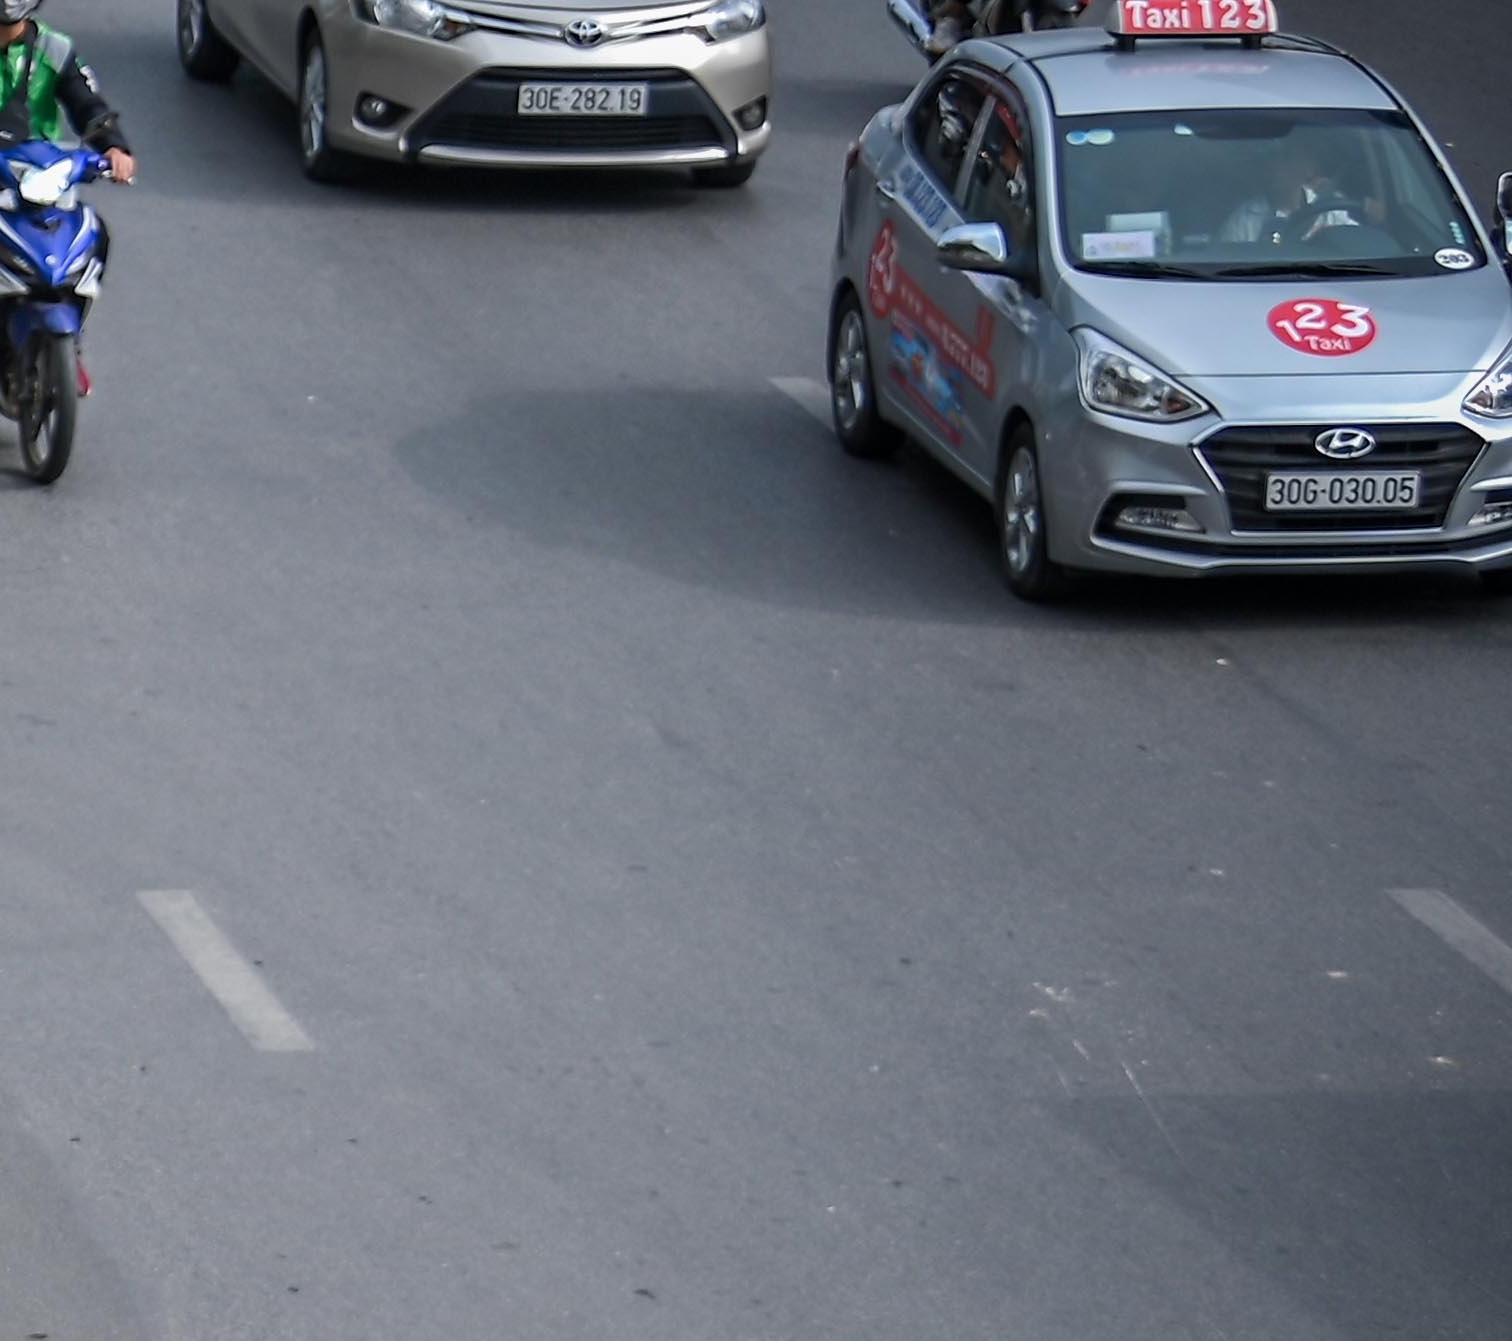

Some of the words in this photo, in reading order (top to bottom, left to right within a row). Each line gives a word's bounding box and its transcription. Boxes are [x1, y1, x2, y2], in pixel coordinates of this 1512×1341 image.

[1125, 1, 1192, 28] Taxi
[1198, 0, 1267, 29] 123
[522, 88, 641, 110] 30E-282.19
[1275, 302, 1372, 342] 123
[1304, 335, 1352, 351] Taxi
[1270, 477, 1415, 505] 30G-030.05
